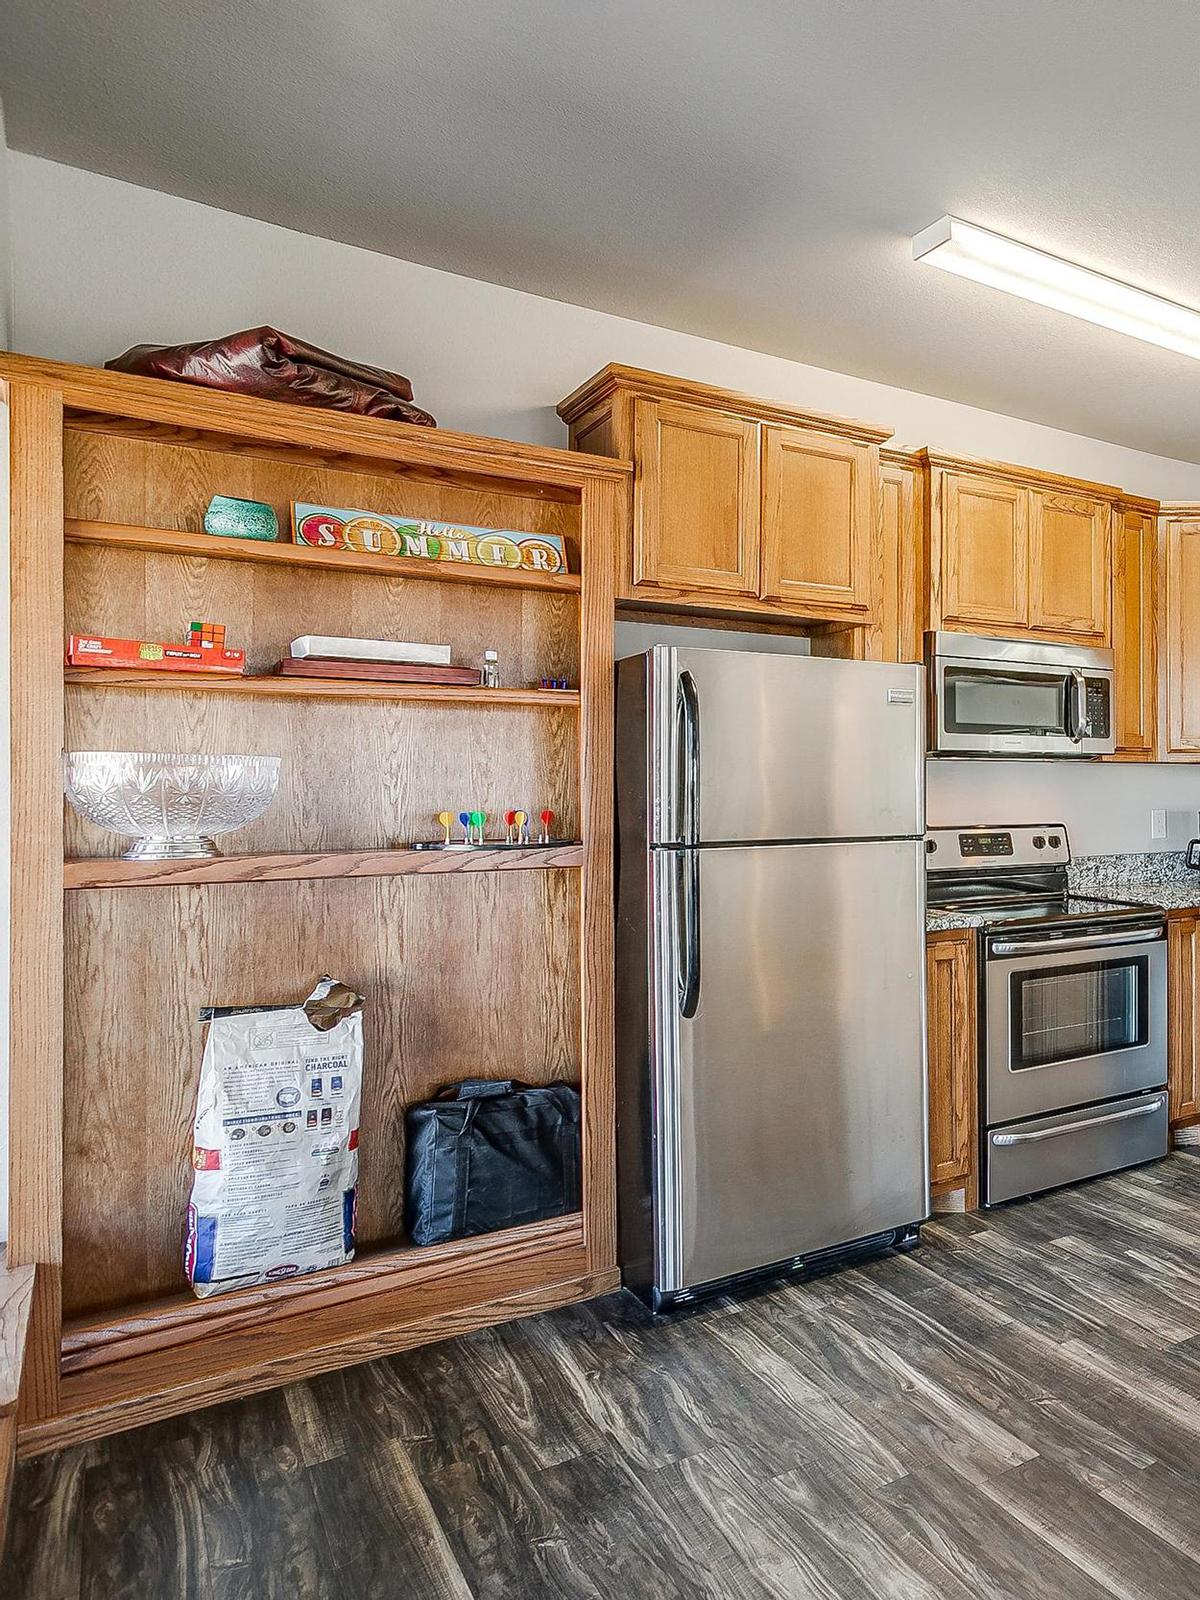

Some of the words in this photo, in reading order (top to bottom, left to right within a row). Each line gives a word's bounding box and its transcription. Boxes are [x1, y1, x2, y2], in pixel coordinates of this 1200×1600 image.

[416, 521, 466, 540] Hello
[318, 523, 551, 570] SUMMER
[305, 1060, 348, 1072] CHARCOAL
